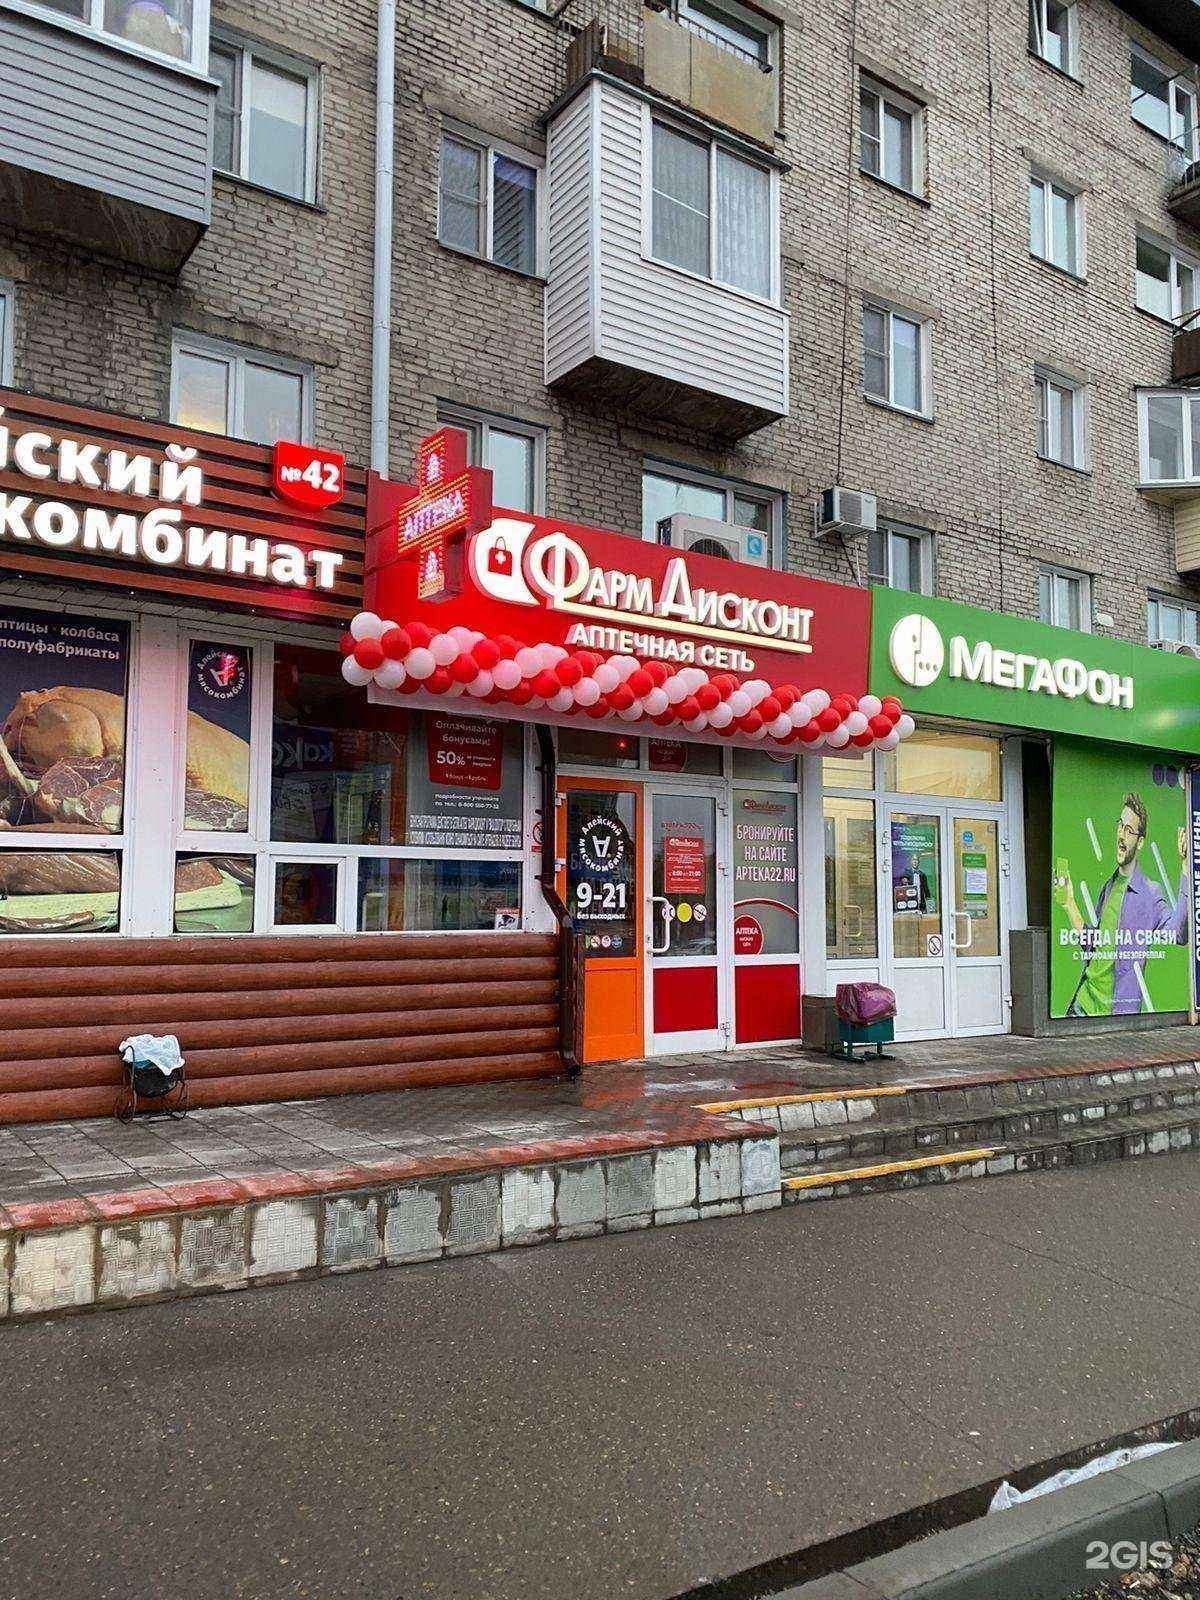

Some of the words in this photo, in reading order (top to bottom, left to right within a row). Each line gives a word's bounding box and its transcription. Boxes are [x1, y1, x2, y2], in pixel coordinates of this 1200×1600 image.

[61, 627, 119, 642] колбаса
[0, 638, 119, 660] полуфабрикаты
[564, 623, 695, 663] АПТЕЧНАЯ
[698, 644, 755, 672] СЕТЬ
[950, 636, 1133, 709] МЕГАФОН
[436, 750, 466, 766] 50%
[736, 824, 795, 842] БРОНИРУЙТЕ
[744, 845, 758, 861] НА
[759, 845, 788, 862] САЙТЕ
[735, 866, 797, 882] APTEKA22.RU
[576, 882, 626, 908] 9-21
[1060, 928, 1111, 947] ВСЕГДА
[1116, 929, 1132, 945] НА
[1135, 929, 1177, 945] СВЯЗИ
